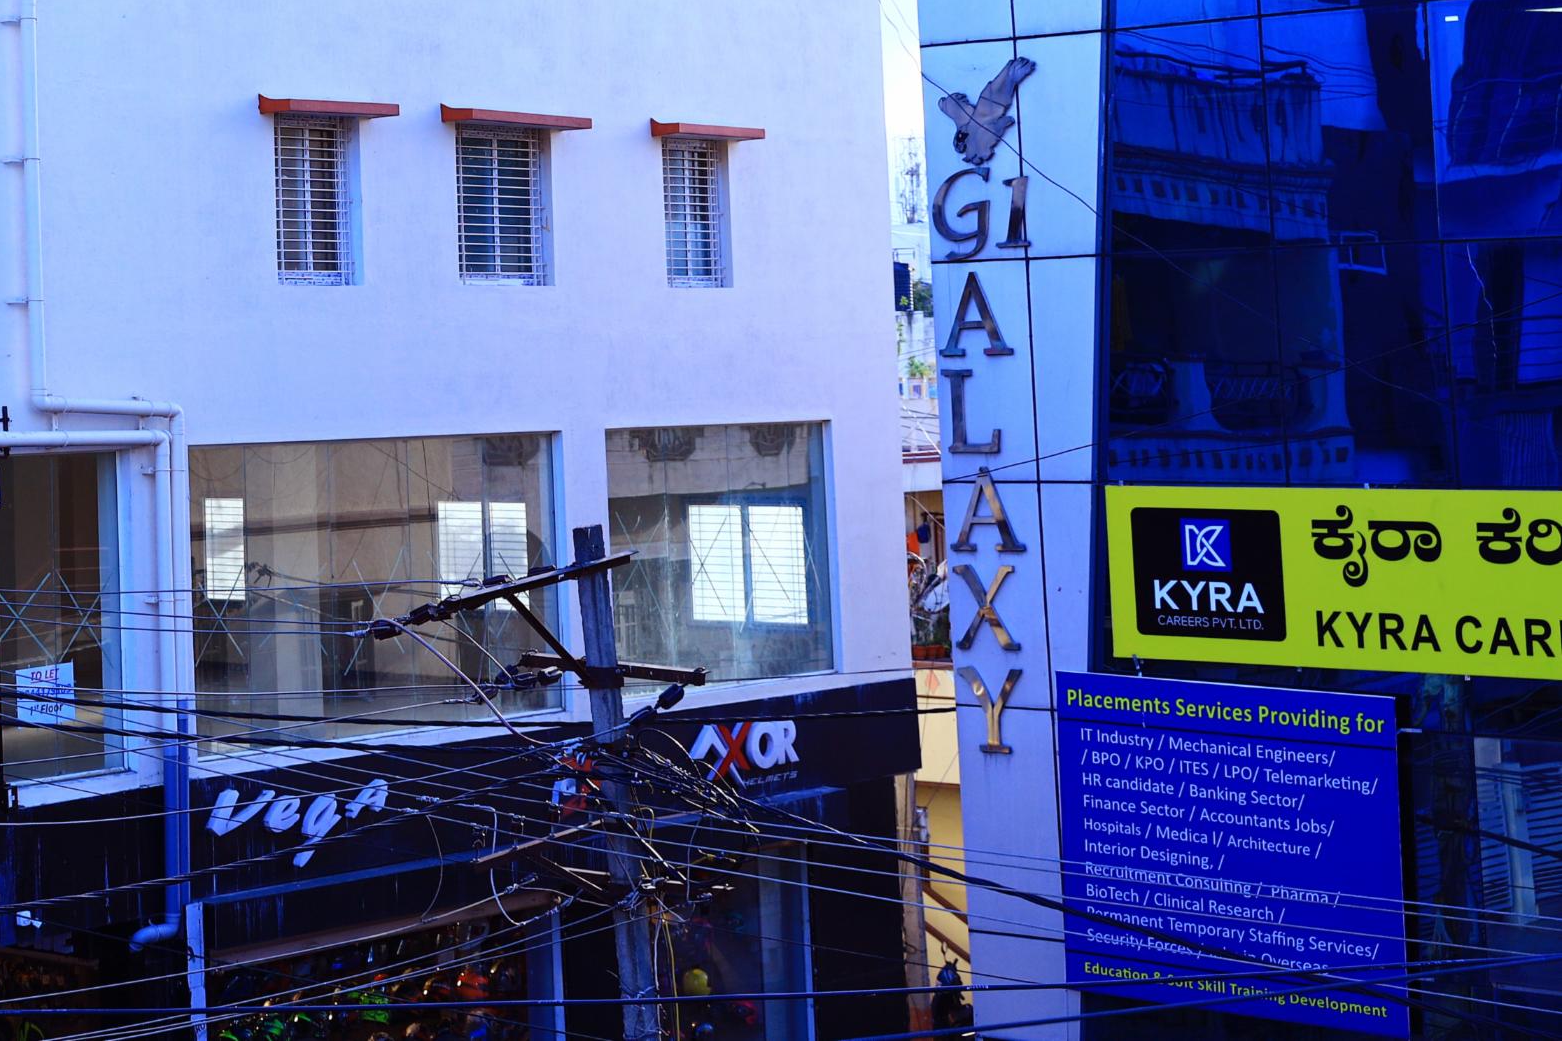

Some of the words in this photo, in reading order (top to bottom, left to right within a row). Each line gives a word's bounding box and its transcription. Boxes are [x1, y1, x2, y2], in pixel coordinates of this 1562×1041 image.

[1154, 579, 1264, 614] KYRA
[1158, 615, 1209, 628] CAREERS
[1212, 618, 1237, 629] PVT.
[1239, 619, 1265, 630] LTD.
[1316, 610, 1442, 652] KYRA
[1455, 615, 1562, 658] CAR
[31, 671, 42, 680] TO
[45, 668, 59, 678] LET
[41, 704, 63, 713] Floor
[1067, 689, 1170, 714] Placements
[1176, 699, 1252, 722] Services
[1259, 706, 1350, 734] Providing
[1356, 712, 1384, 733] for
[689, 720, 799, 789] AXOR
[1081, 728, 1092, 741] IT
[1097, 729, 1154, 750] Industry
[1169, 736, 1251, 757] Mechanical
[1256, 745, 1335, 767] Engineers/
[1082, 772, 1102, 787] HR
[1105, 777, 1174, 795] candidate
[1189, 784, 1247, 805] Banking
[1251, 790, 1305, 811] Sector/
[1092, 751, 1120, 766] BPO
[1136, 755, 1164, 771] KPO
[1180, 760, 1209, 776] ITES
[1224, 765, 1259, 783] LPO/
[1263, 768, 1378, 795] Telemarketing/
[1083, 794, 1136, 813] Finance
[1140, 801, 1185, 818] Sector
[1200, 808, 1290, 830] Accountants
[1294, 818, 1334, 837] Jobs/
[1084, 818, 1141, 836] Hospitals
[1227, 834, 1311, 856] Architecture
[1084, 839, 1136, 857] Interior
[1140, 846, 1213, 869] Designing,
[1085, 862, 1171, 886] Recruitment
[1176, 873, 1251, 898] Consulting
[1271, 885, 1328, 903] Pharma
[1086, 883, 1138, 903] BioTech
[1154, 892, 1204, 911] Clinical
[1209, 900, 1274, 921] Research
[1087, 928, 1142, 950] Security
[1167, 916, 1245, 943] Temporary
[1249, 928, 1304, 951] Staffing
[1309, 936, 1379, 960] Services/
[1084, 962, 1148, 980] Education
[1197, 979, 1226, 994] Skill
[1290, 993, 1387, 1018] Development
